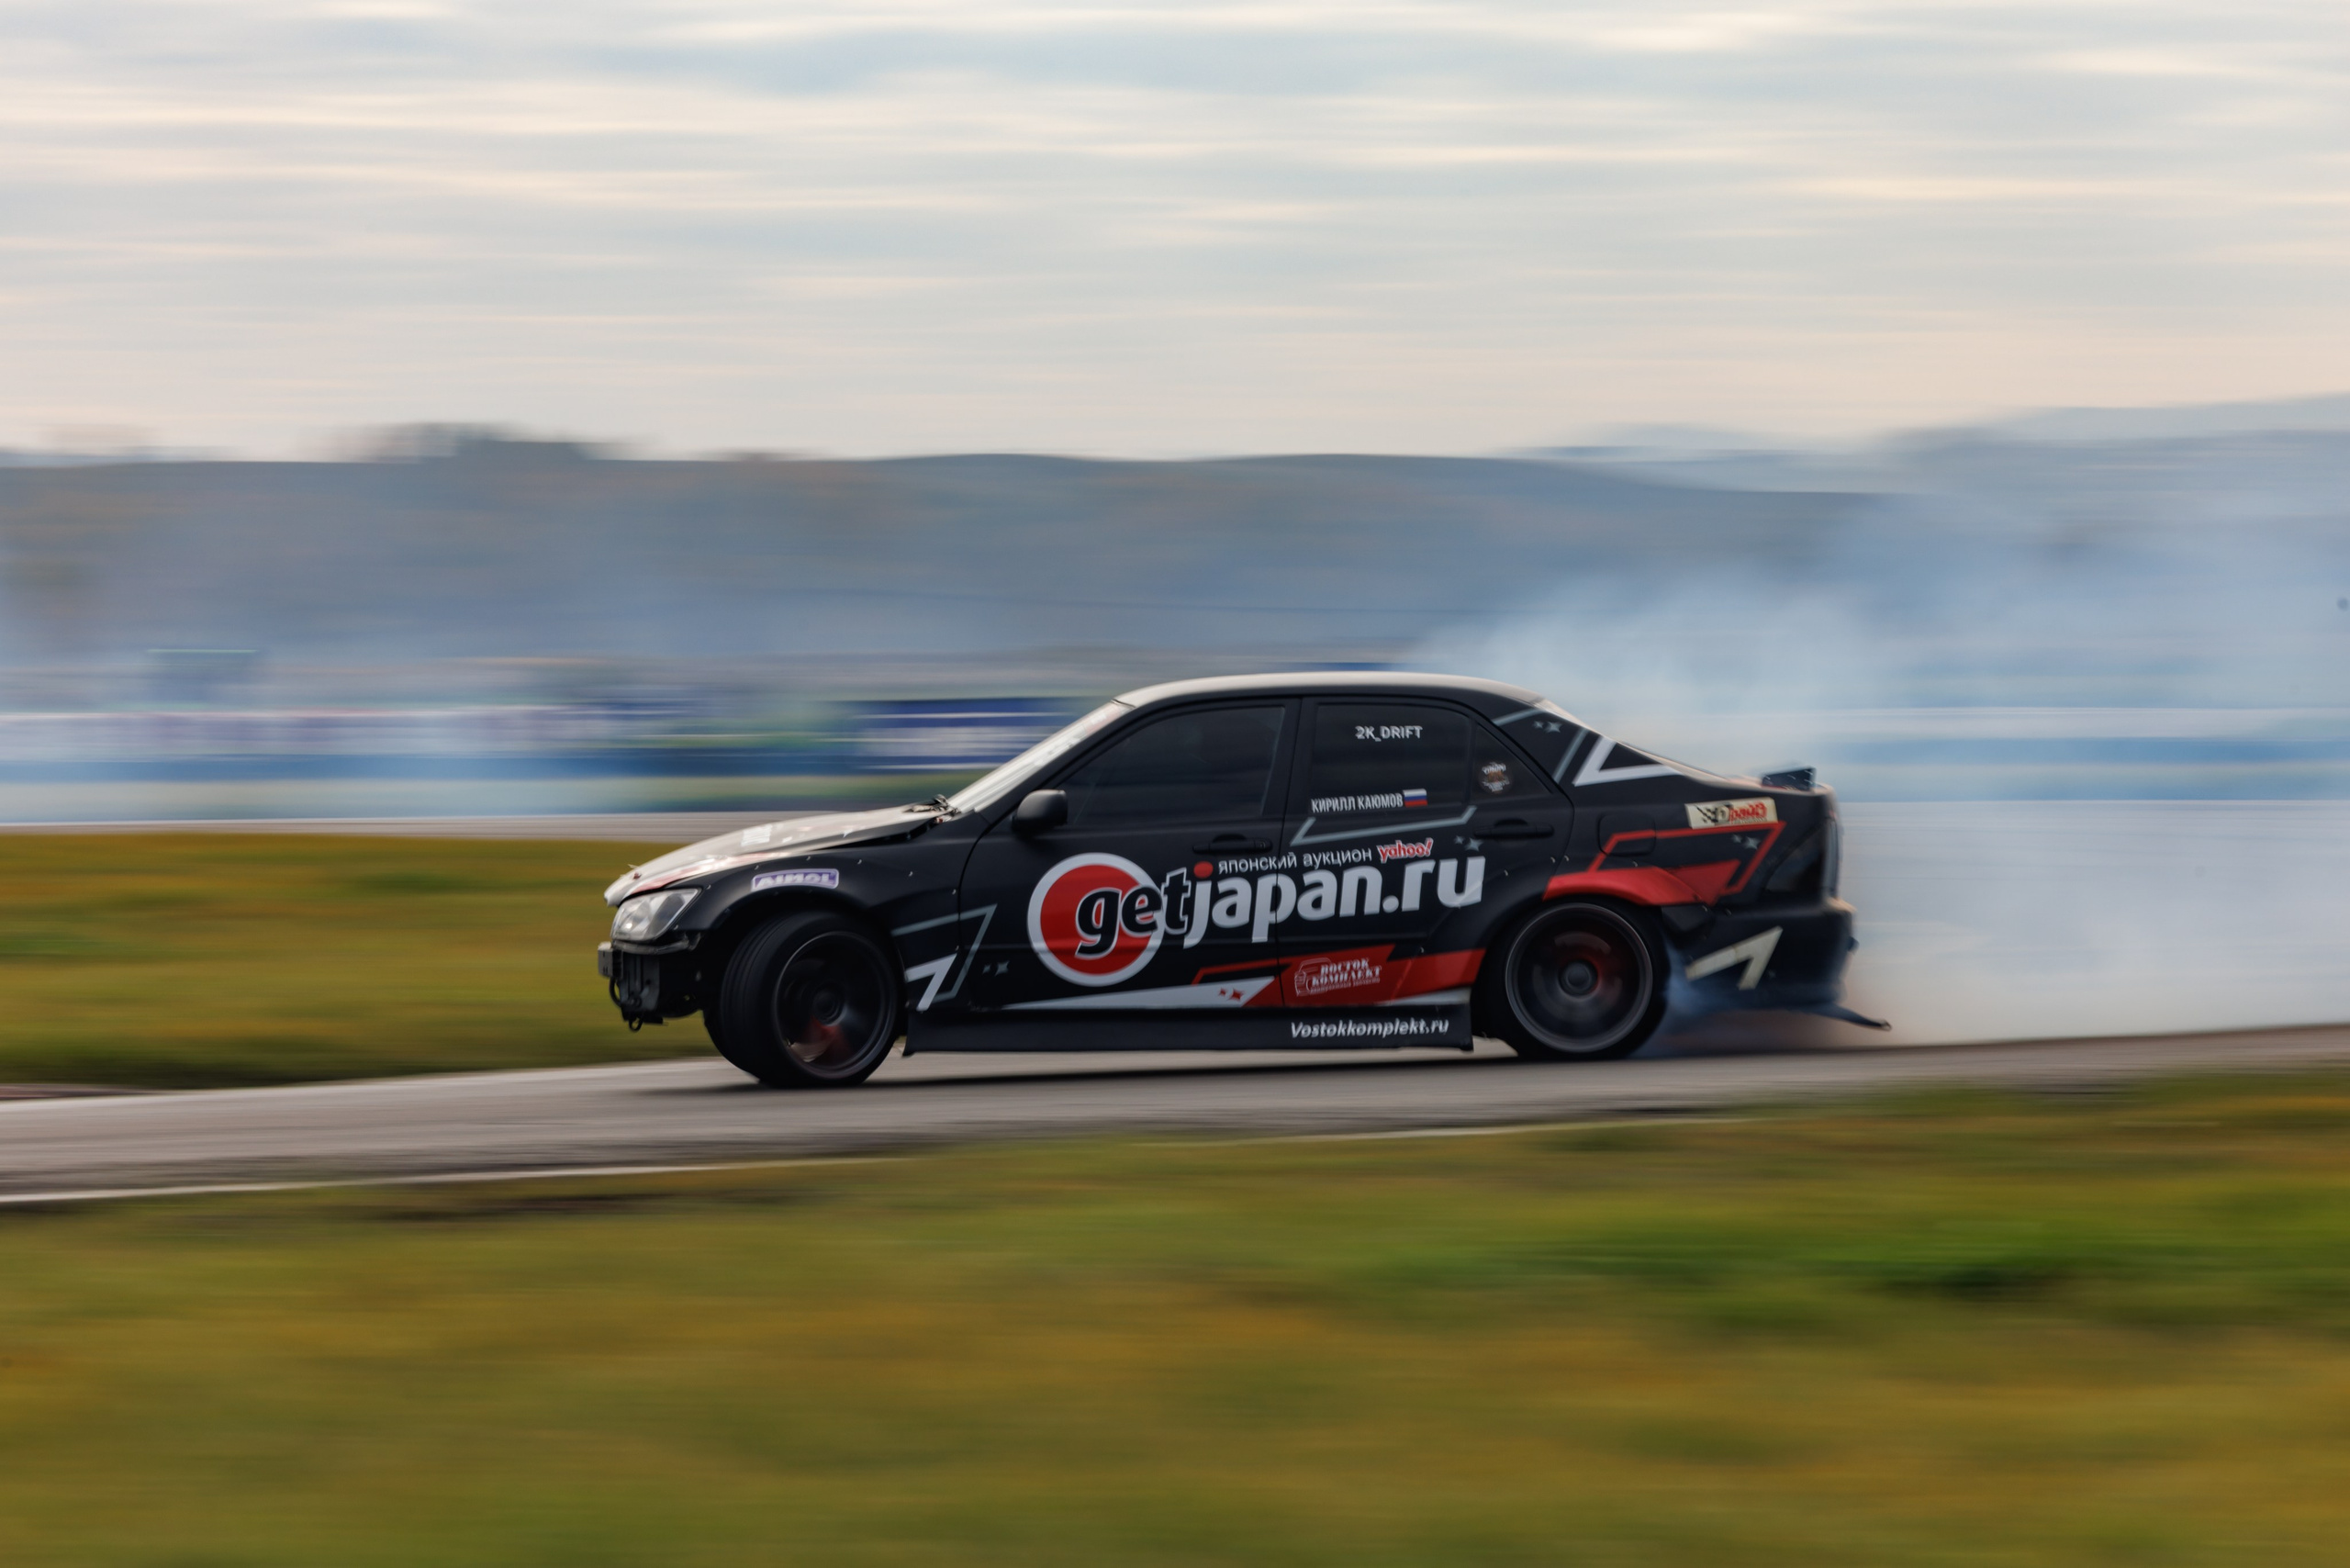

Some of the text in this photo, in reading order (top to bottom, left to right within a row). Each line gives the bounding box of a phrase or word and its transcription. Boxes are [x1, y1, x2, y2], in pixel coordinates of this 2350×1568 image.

[1354, 725, 1423, 742] 2K_DRIFT
[1311, 792, 1404, 813] КИРИЛЛ КАЮМОВ
[1218, 847, 1372, 875] японский аукцион
[1320, 958, 1370, 975] ВОСТОК
[1291, 1017, 1449, 1038] Vostokkomplekt.ru
